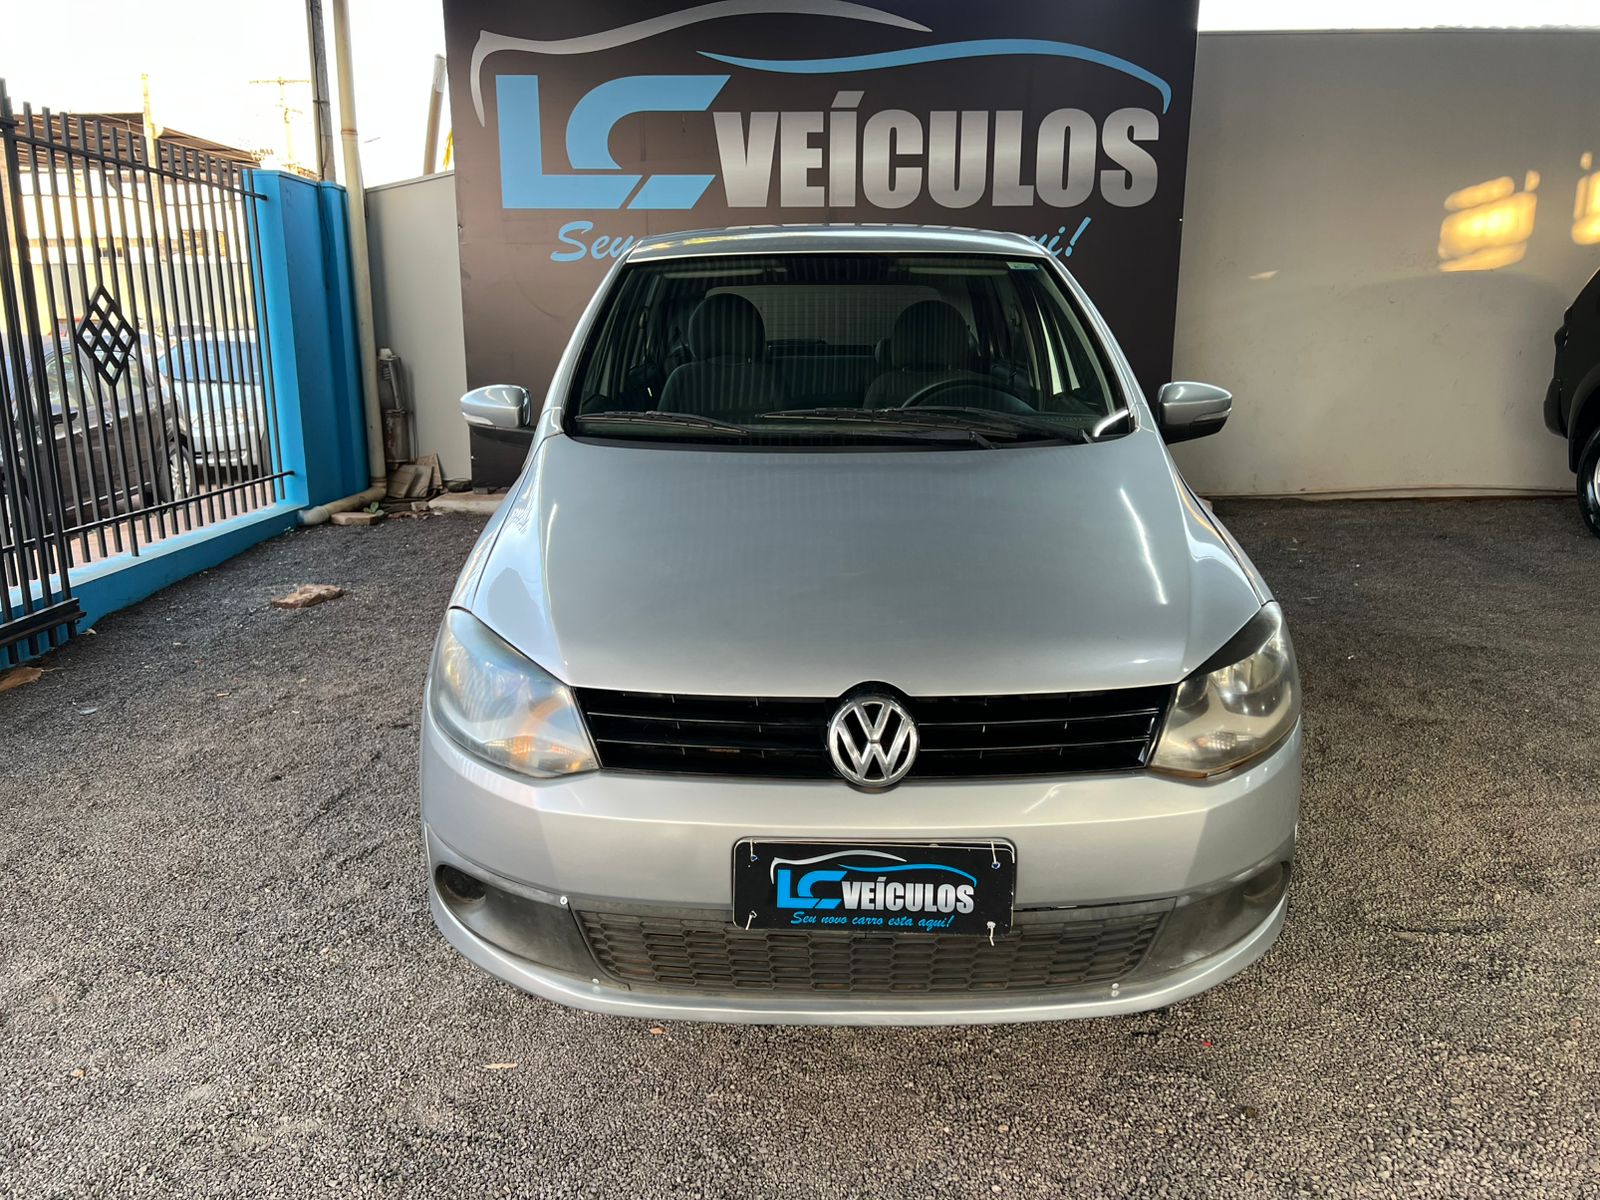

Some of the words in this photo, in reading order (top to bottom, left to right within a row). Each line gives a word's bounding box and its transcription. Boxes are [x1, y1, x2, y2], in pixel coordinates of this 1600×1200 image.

[495, 74, 731, 210] LC
[712, 90, 1160, 209] VEÍCULOS
[829, 697, 918, 787] VW
[776, 869, 848, 910] LC
[841, 876, 975, 914] VEÍCULOS
[790, 911, 817, 925] Seu
[821, 914, 847, 924] novo
[851, 915, 884, 925] carro
[888, 915, 914, 927] esta
[917, 915, 955, 931] aqui!
